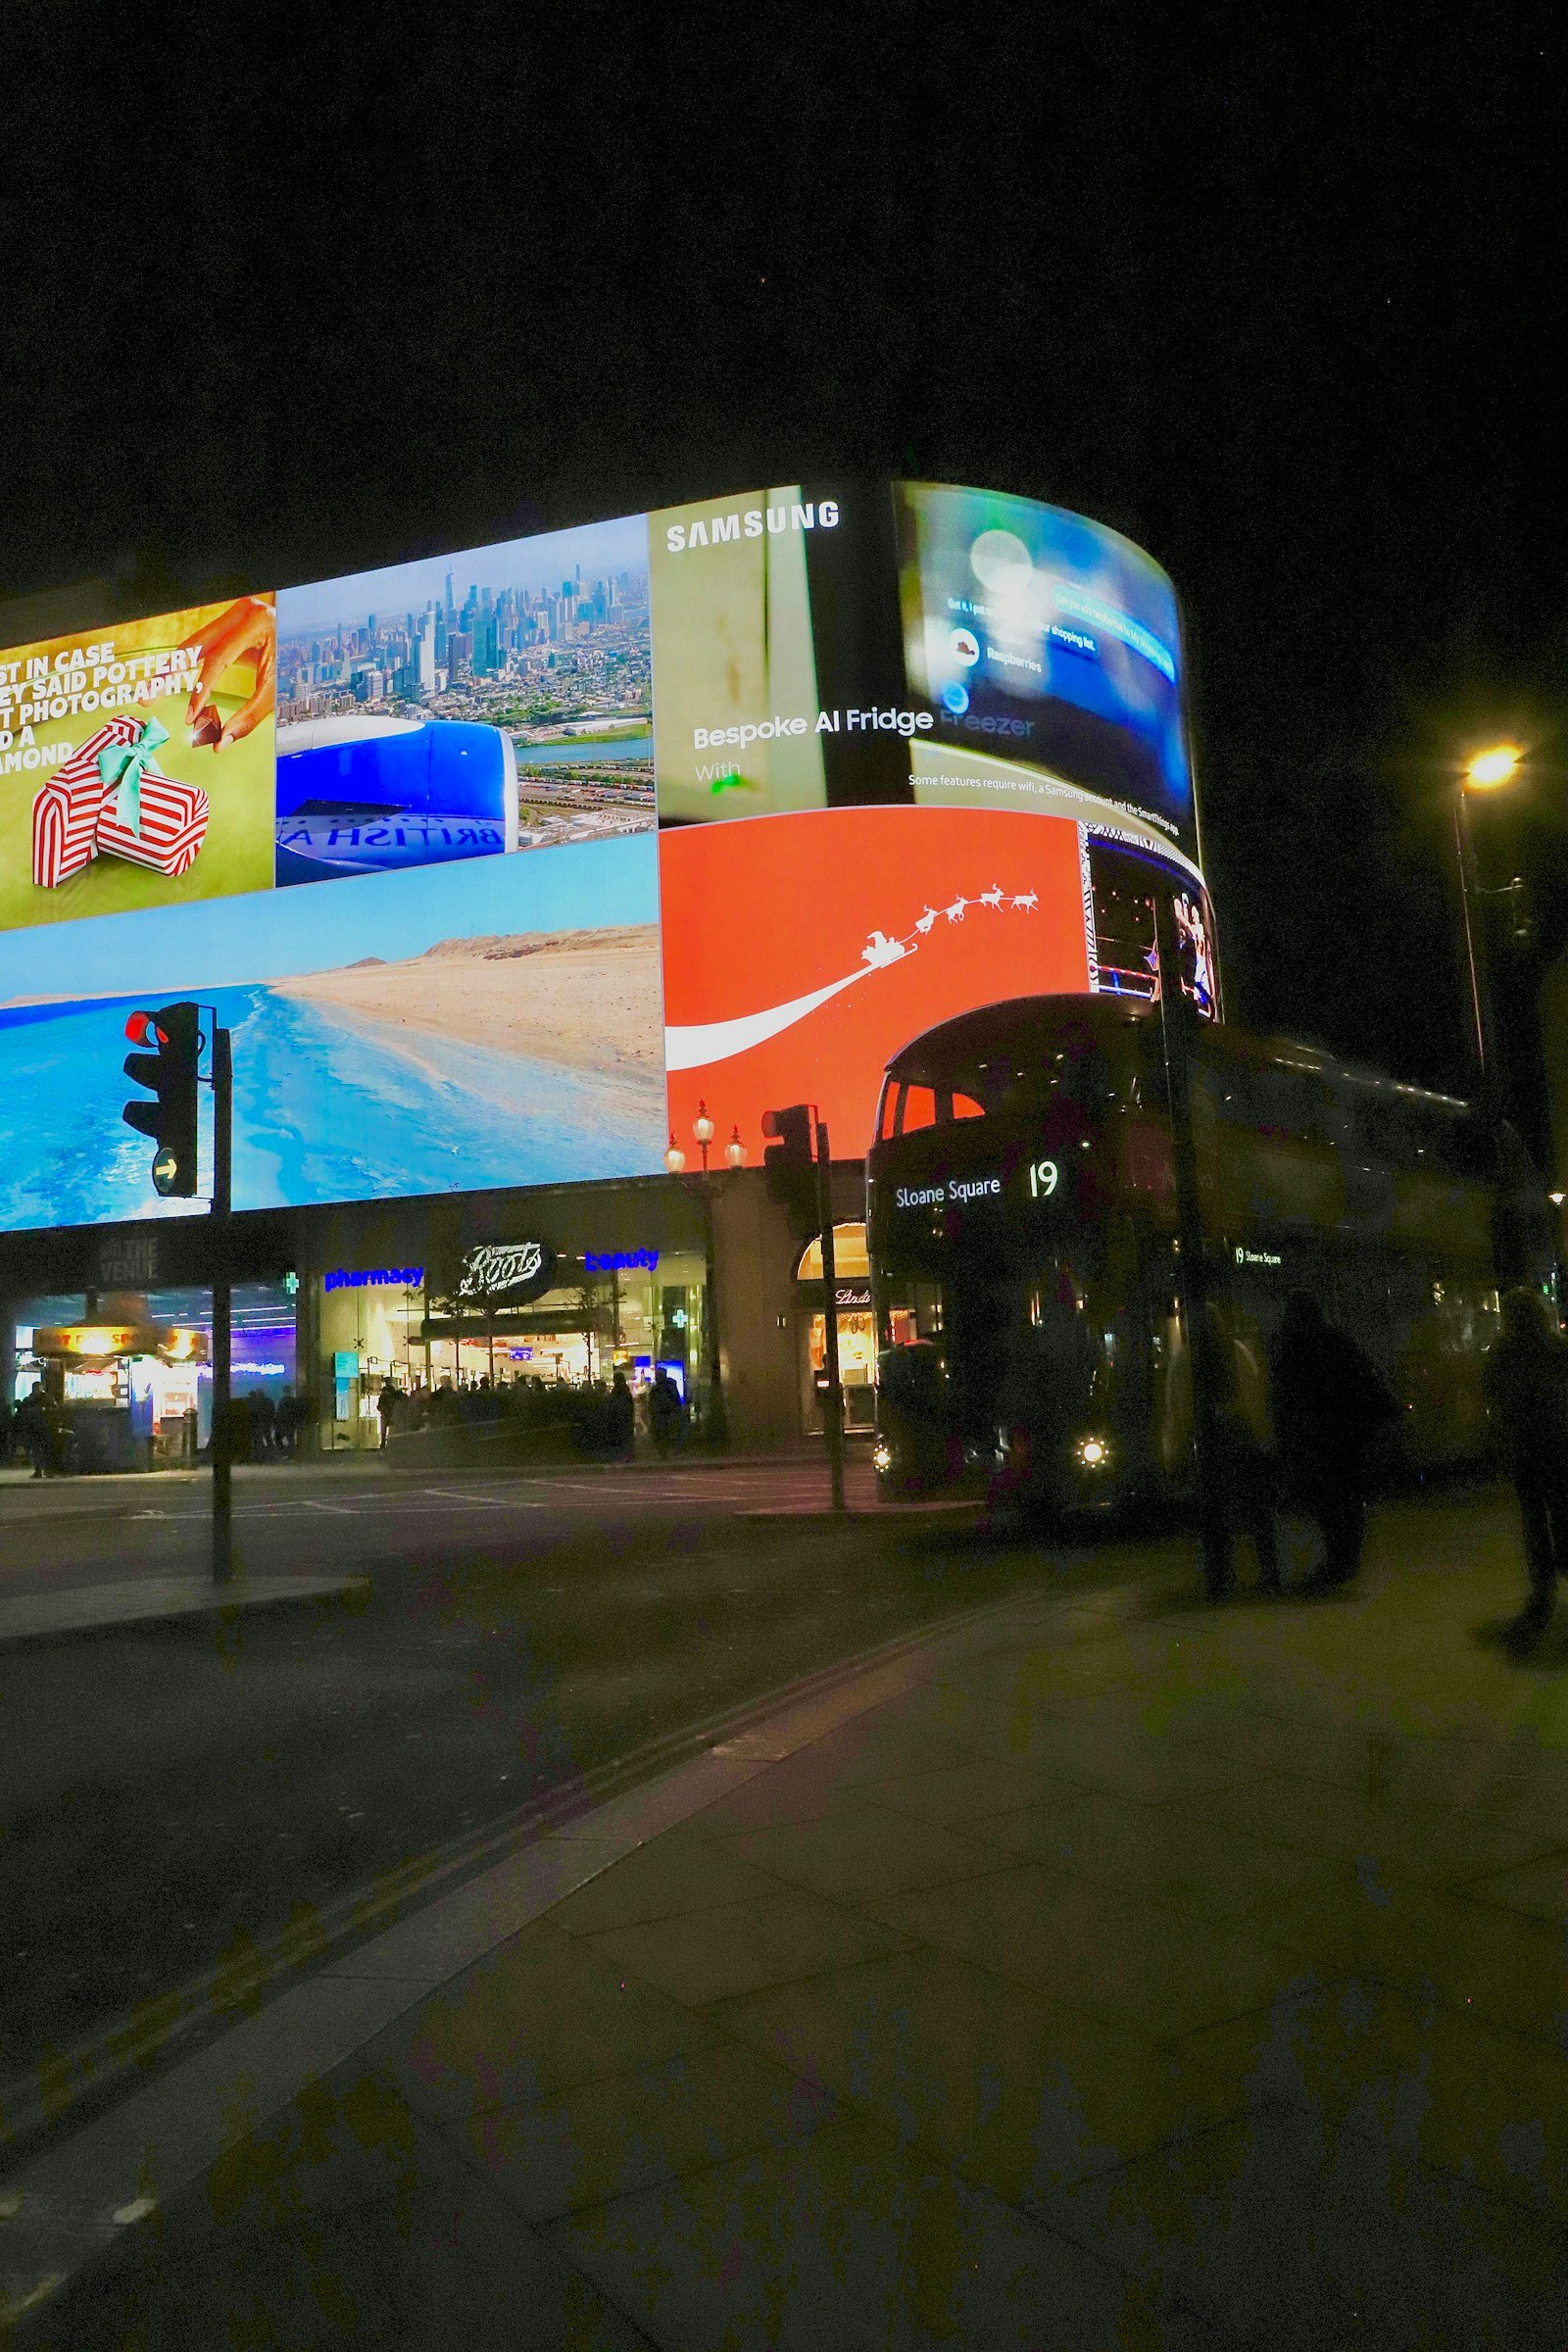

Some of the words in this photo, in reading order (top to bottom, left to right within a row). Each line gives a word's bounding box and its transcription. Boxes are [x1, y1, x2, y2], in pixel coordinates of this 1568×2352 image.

[666, 501, 840, 553] SAMSUNG
[1052, 625, 1083, 648] shopping
[26, 656, 48, 679] IN
[54, 642, 116, 673] CASE
[32, 671, 86, 700] SAID
[93, 645, 203, 688] POTTERY
[987, 647, 1042, 673] Raspberries
[0, 707, 14, 729] T
[20, 669, 203, 725] PHOTOGRAPHY,
[19, 725, 35, 748] A
[693, 716, 808, 750] Bespoke
[814, 710, 840, 734] AI
[846, 706, 934, 736] Fridge
[940, 709, 1036, 737] Freezer
[695, 760, 741, 781] With
[908, 774, 938, 786] Some
[940, 775, 981, 787] features
[983, 778, 1017, 791] require
[1018, 780, 1037, 794] wifi,
[1038, 784, 1044, 793] a
[1047, 784, 1083, 803] Samsung
[1083, 793, 1112, 807] account
[1113, 800, 1126, 811] and
[1127, 804, 1137, 815] the
[1138, 807, 1170, 831] SmartThings
[897, 1188, 945, 1207] Sloane
[949, 1179, 1001, 1202] Square
[1030, 1160, 1058, 1198] 19
[454, 1242, 542, 1296] Boots
[1236, 1247, 1244, 1264] 19
[1246, 1250, 1263, 1262] Sloane
[1263, 1252, 1281, 1265] Square
[324, 1267, 424, 1293] pharmacy
